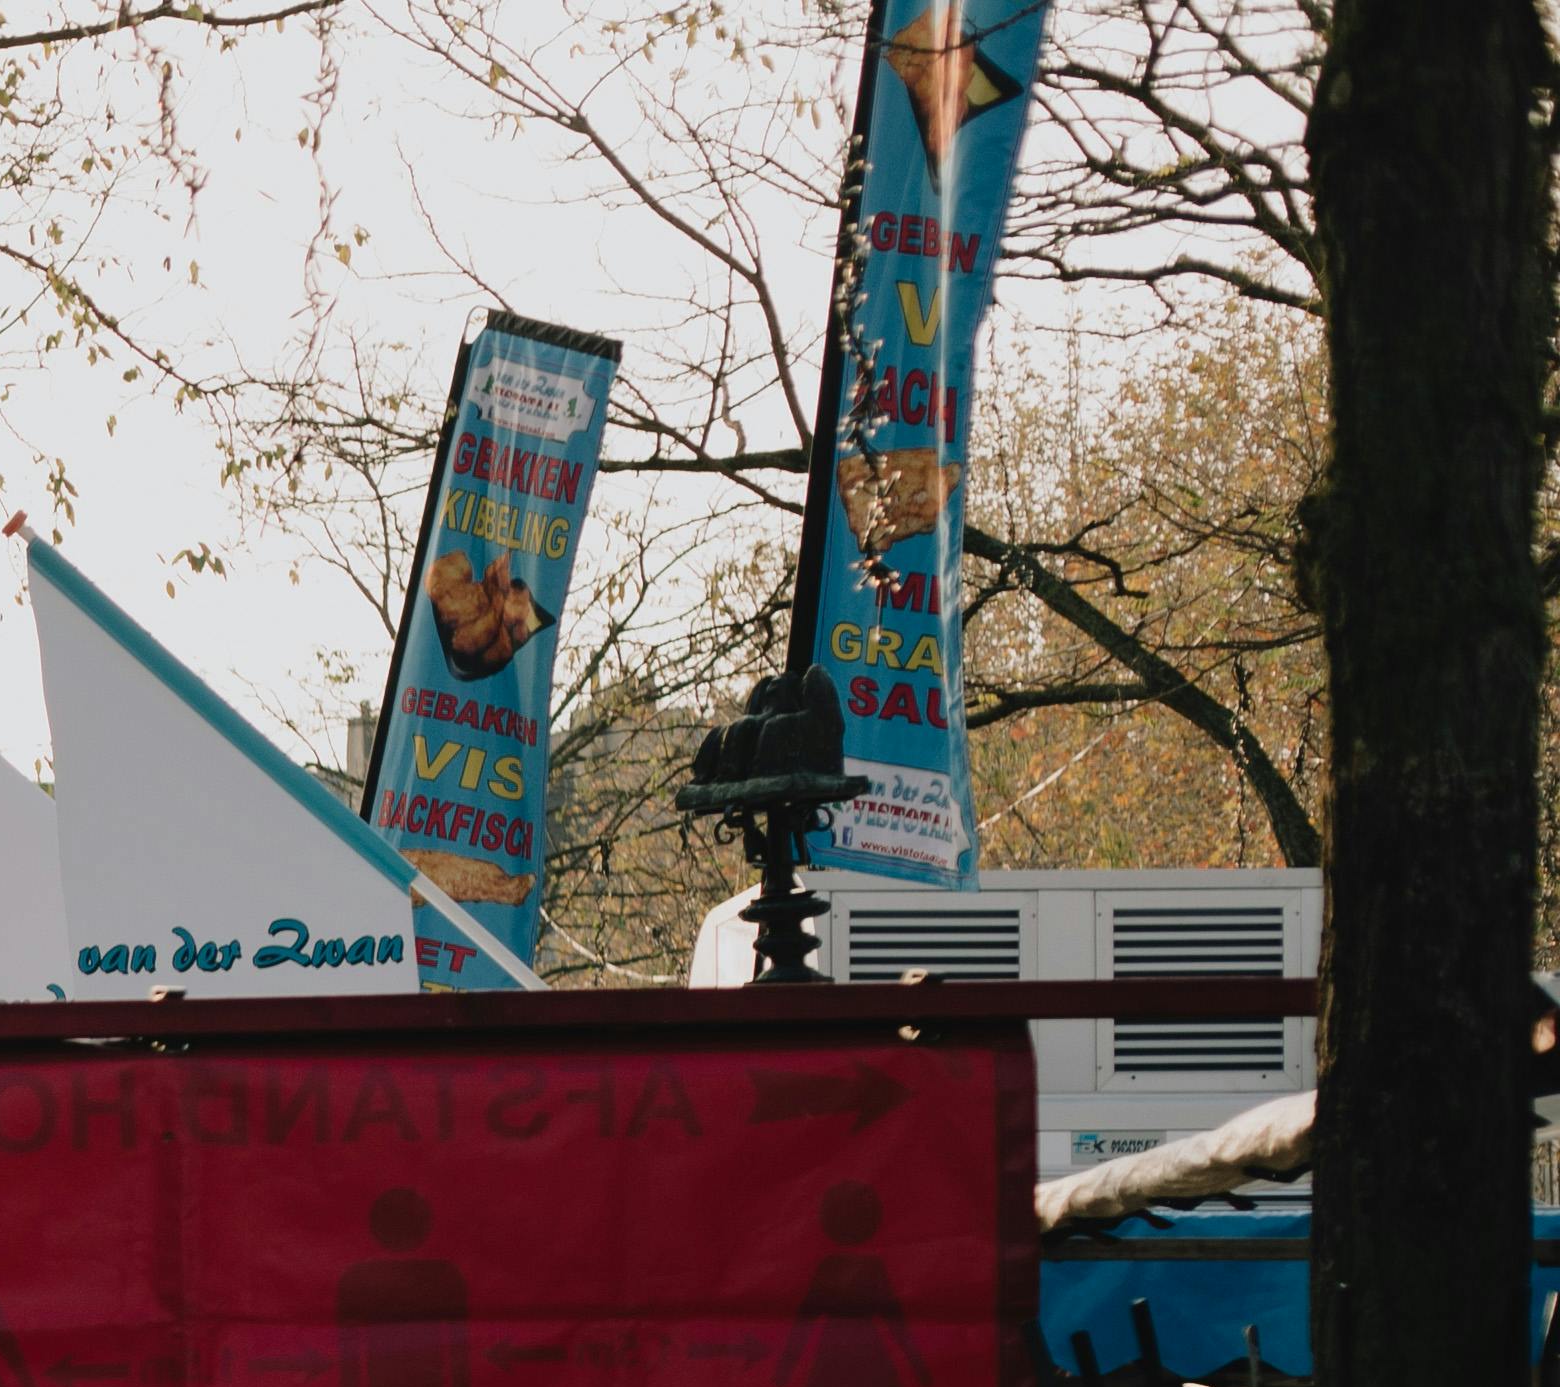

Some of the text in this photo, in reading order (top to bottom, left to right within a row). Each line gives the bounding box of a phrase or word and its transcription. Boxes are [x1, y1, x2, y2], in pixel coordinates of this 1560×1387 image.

[439, 487, 570, 561] KIBBELING
[413, 733, 525, 801] VIS
[78, 939, 156, 975] van
[172, 926, 241, 973] der
[415, 936, 478, 974] ET
